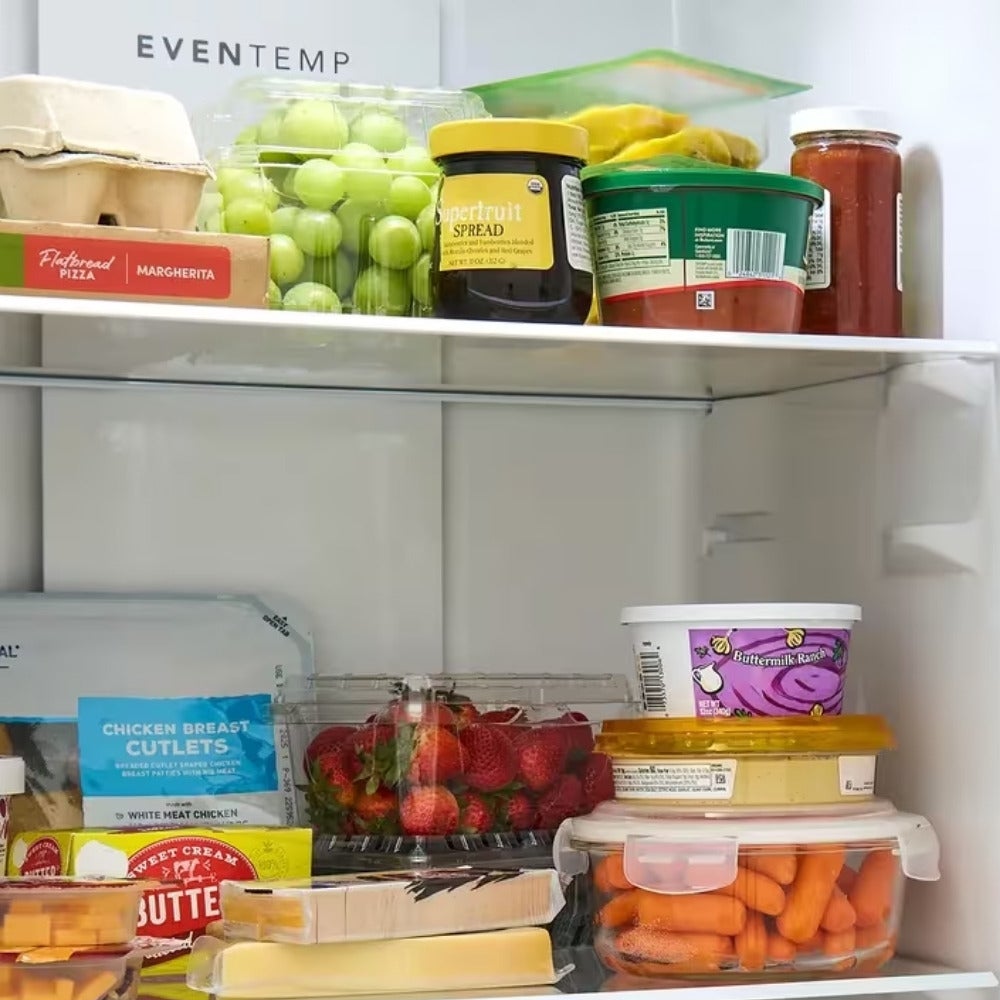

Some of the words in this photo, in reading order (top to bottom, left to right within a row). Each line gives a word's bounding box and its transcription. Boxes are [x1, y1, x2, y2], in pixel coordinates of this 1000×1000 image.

[137, 34, 350, 74] EVENTEMP
[453, 223, 504, 238] SPREAD
[38, 248, 116, 271] Flatbread
[60, 269, 95, 280] PIZZA
[136, 264, 215, 280] MARGHERITA
[262, 614, 279, 629] OPEN
[732, 649, 795, 667] Buttermilk
[797, 648, 826, 663] Ranch
[102, 723, 176, 735] CHICKEN
[183, 720, 250, 735] BREAST
[126, 738, 229, 756] CUTLETS
[179, 760, 207, 768] SHAPED
[209, 759, 241, 767] CHICKEN
[121, 769, 150, 777] BREAST
[128, 811, 161, 820] WHITE
[163, 810, 192, 819] MEAT
[193, 808, 238, 819] CHICKEN
[182, 846, 239, 867] CREAM
[138, 886, 221, 928] BUTTE
